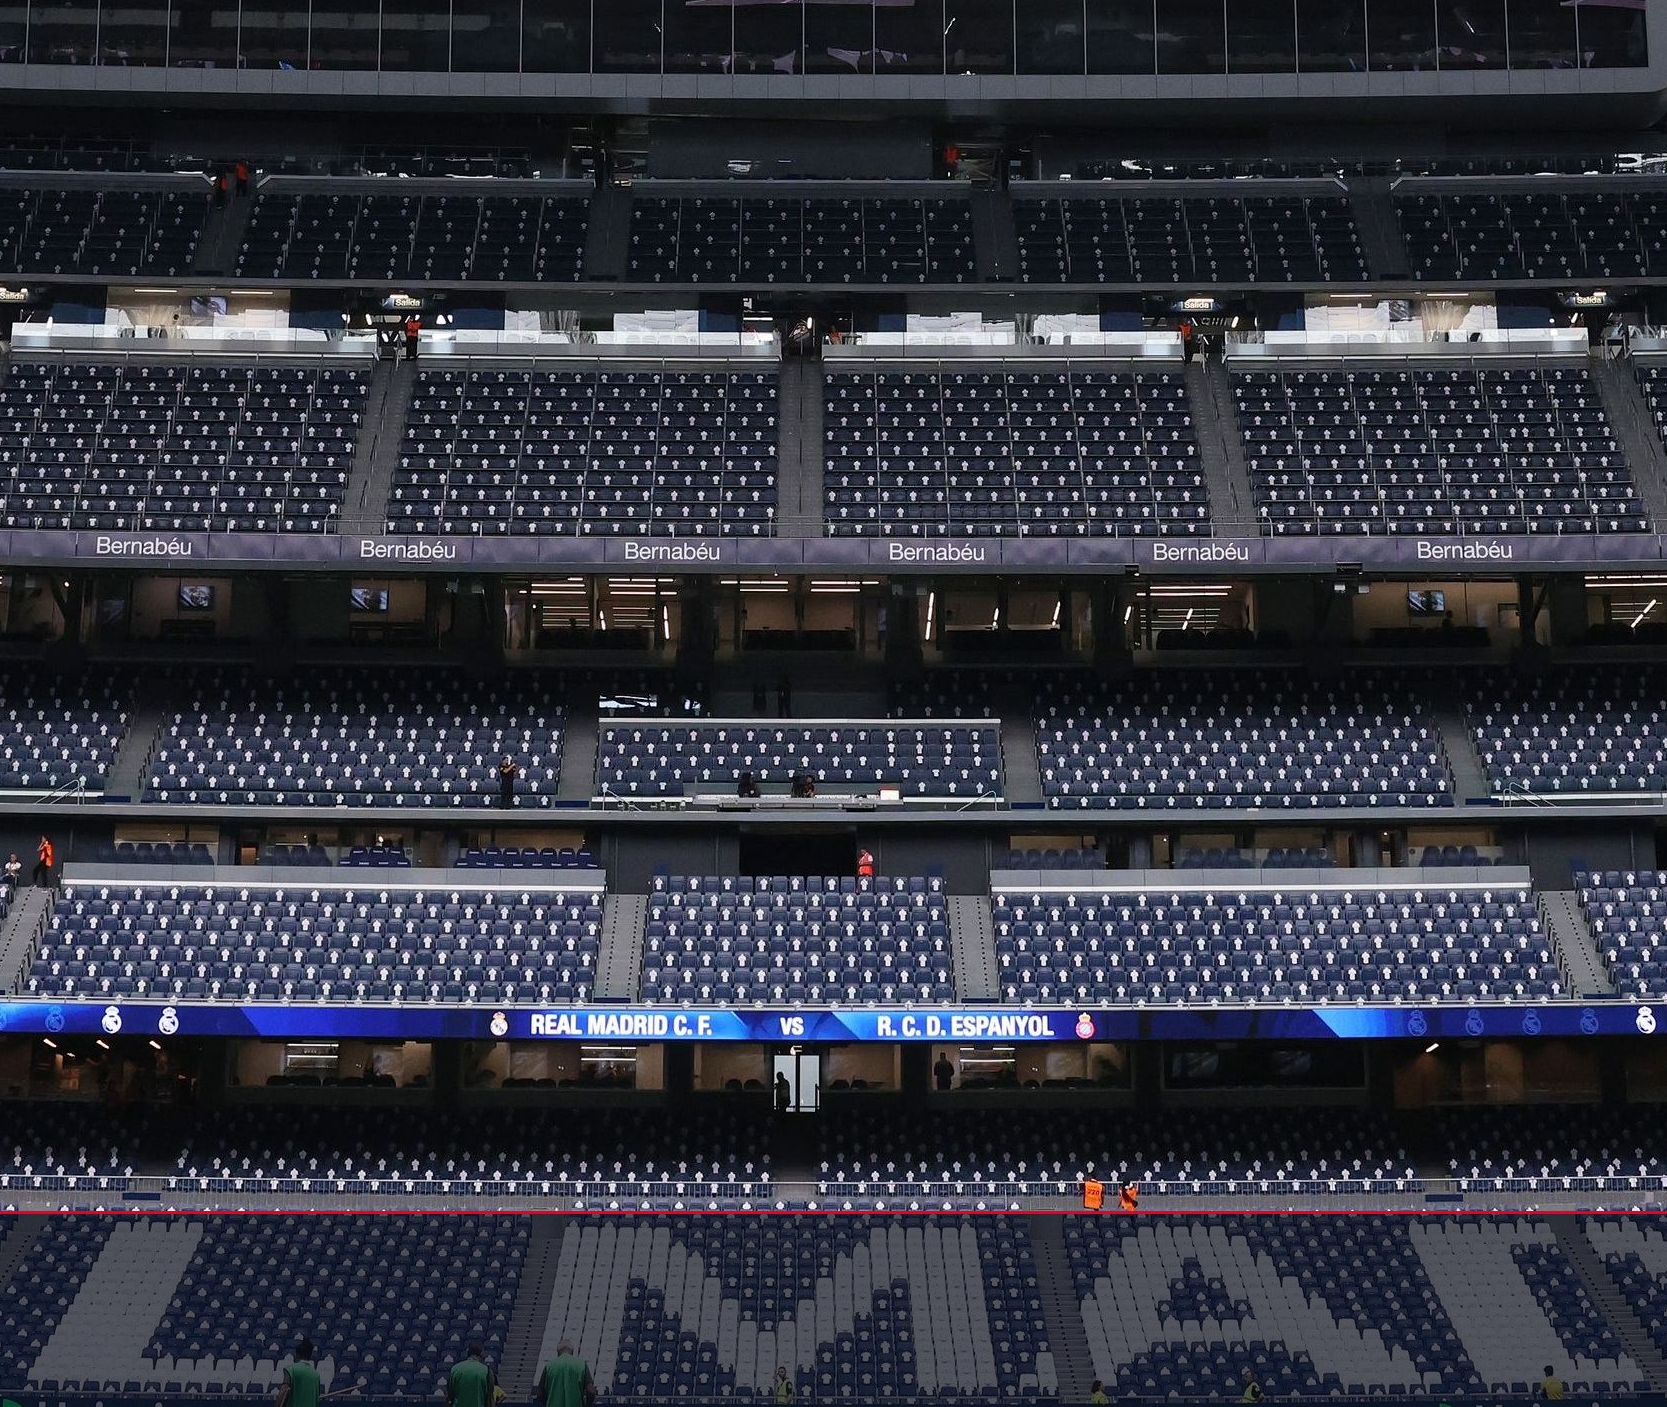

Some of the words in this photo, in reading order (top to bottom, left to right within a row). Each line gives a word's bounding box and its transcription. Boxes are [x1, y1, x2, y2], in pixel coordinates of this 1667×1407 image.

[96, 535, 192, 557] Bernabéu
[360, 538, 457, 560] Bernabéu
[624, 541, 720, 562] Bernabéu
[889, 541, 985, 562] Bernabéu
[1153, 541, 1249, 562] Bernabéu
[1417, 539, 1513, 560] Bernabéu
[530, 1014, 584, 1035] REAL
[588, 1015, 668, 1036] MADRID
[673, 1015, 694, 1036] C.
[698, 1015, 712, 1036] F.
[780, 1016, 805, 1036] VS
[877, 1015, 898, 1036] R.
[902, 1015, 922, 1036] C.
[927, 1015, 947, 1037] D.
[951, 1015, 1055, 1037] ESPANYOL
